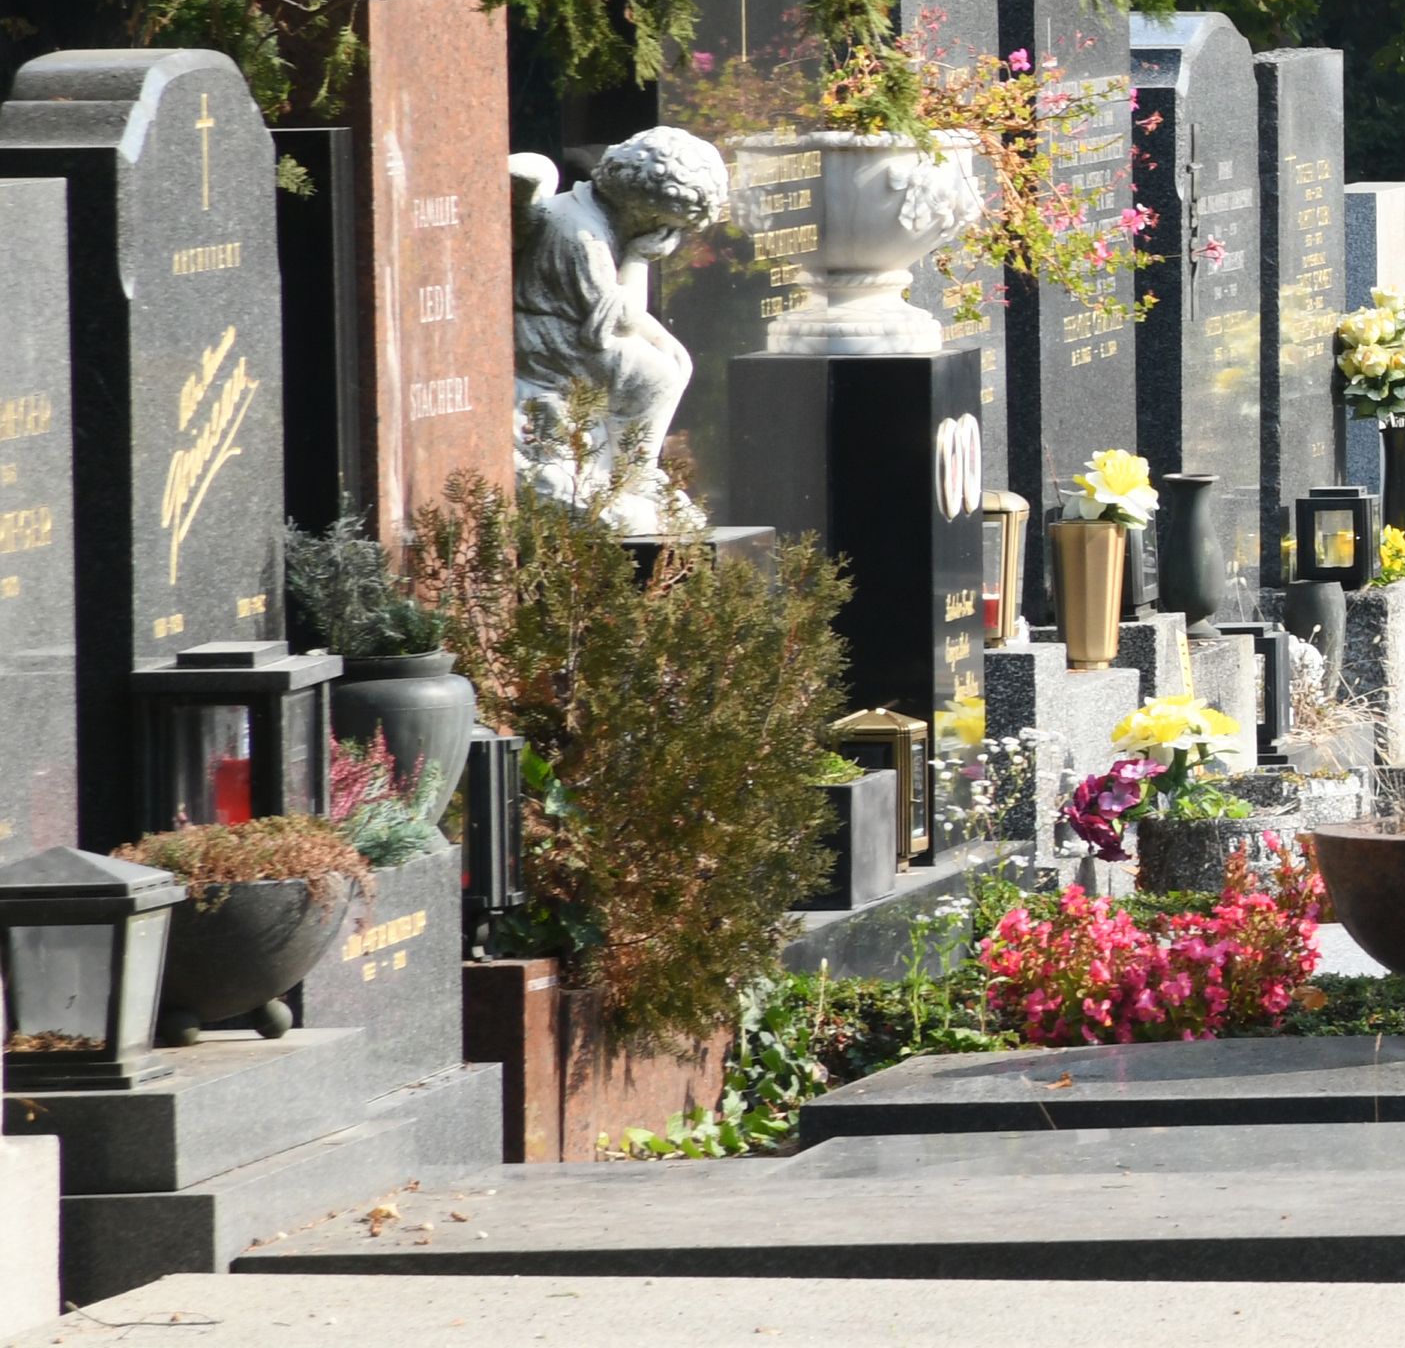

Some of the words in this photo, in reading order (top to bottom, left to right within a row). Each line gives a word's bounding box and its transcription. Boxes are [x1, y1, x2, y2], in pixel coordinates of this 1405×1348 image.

[414, 195, 459, 229] FAMILIE
[419, 284, 455, 323] LEDL
[409, 376, 472, 421] STACHERL
